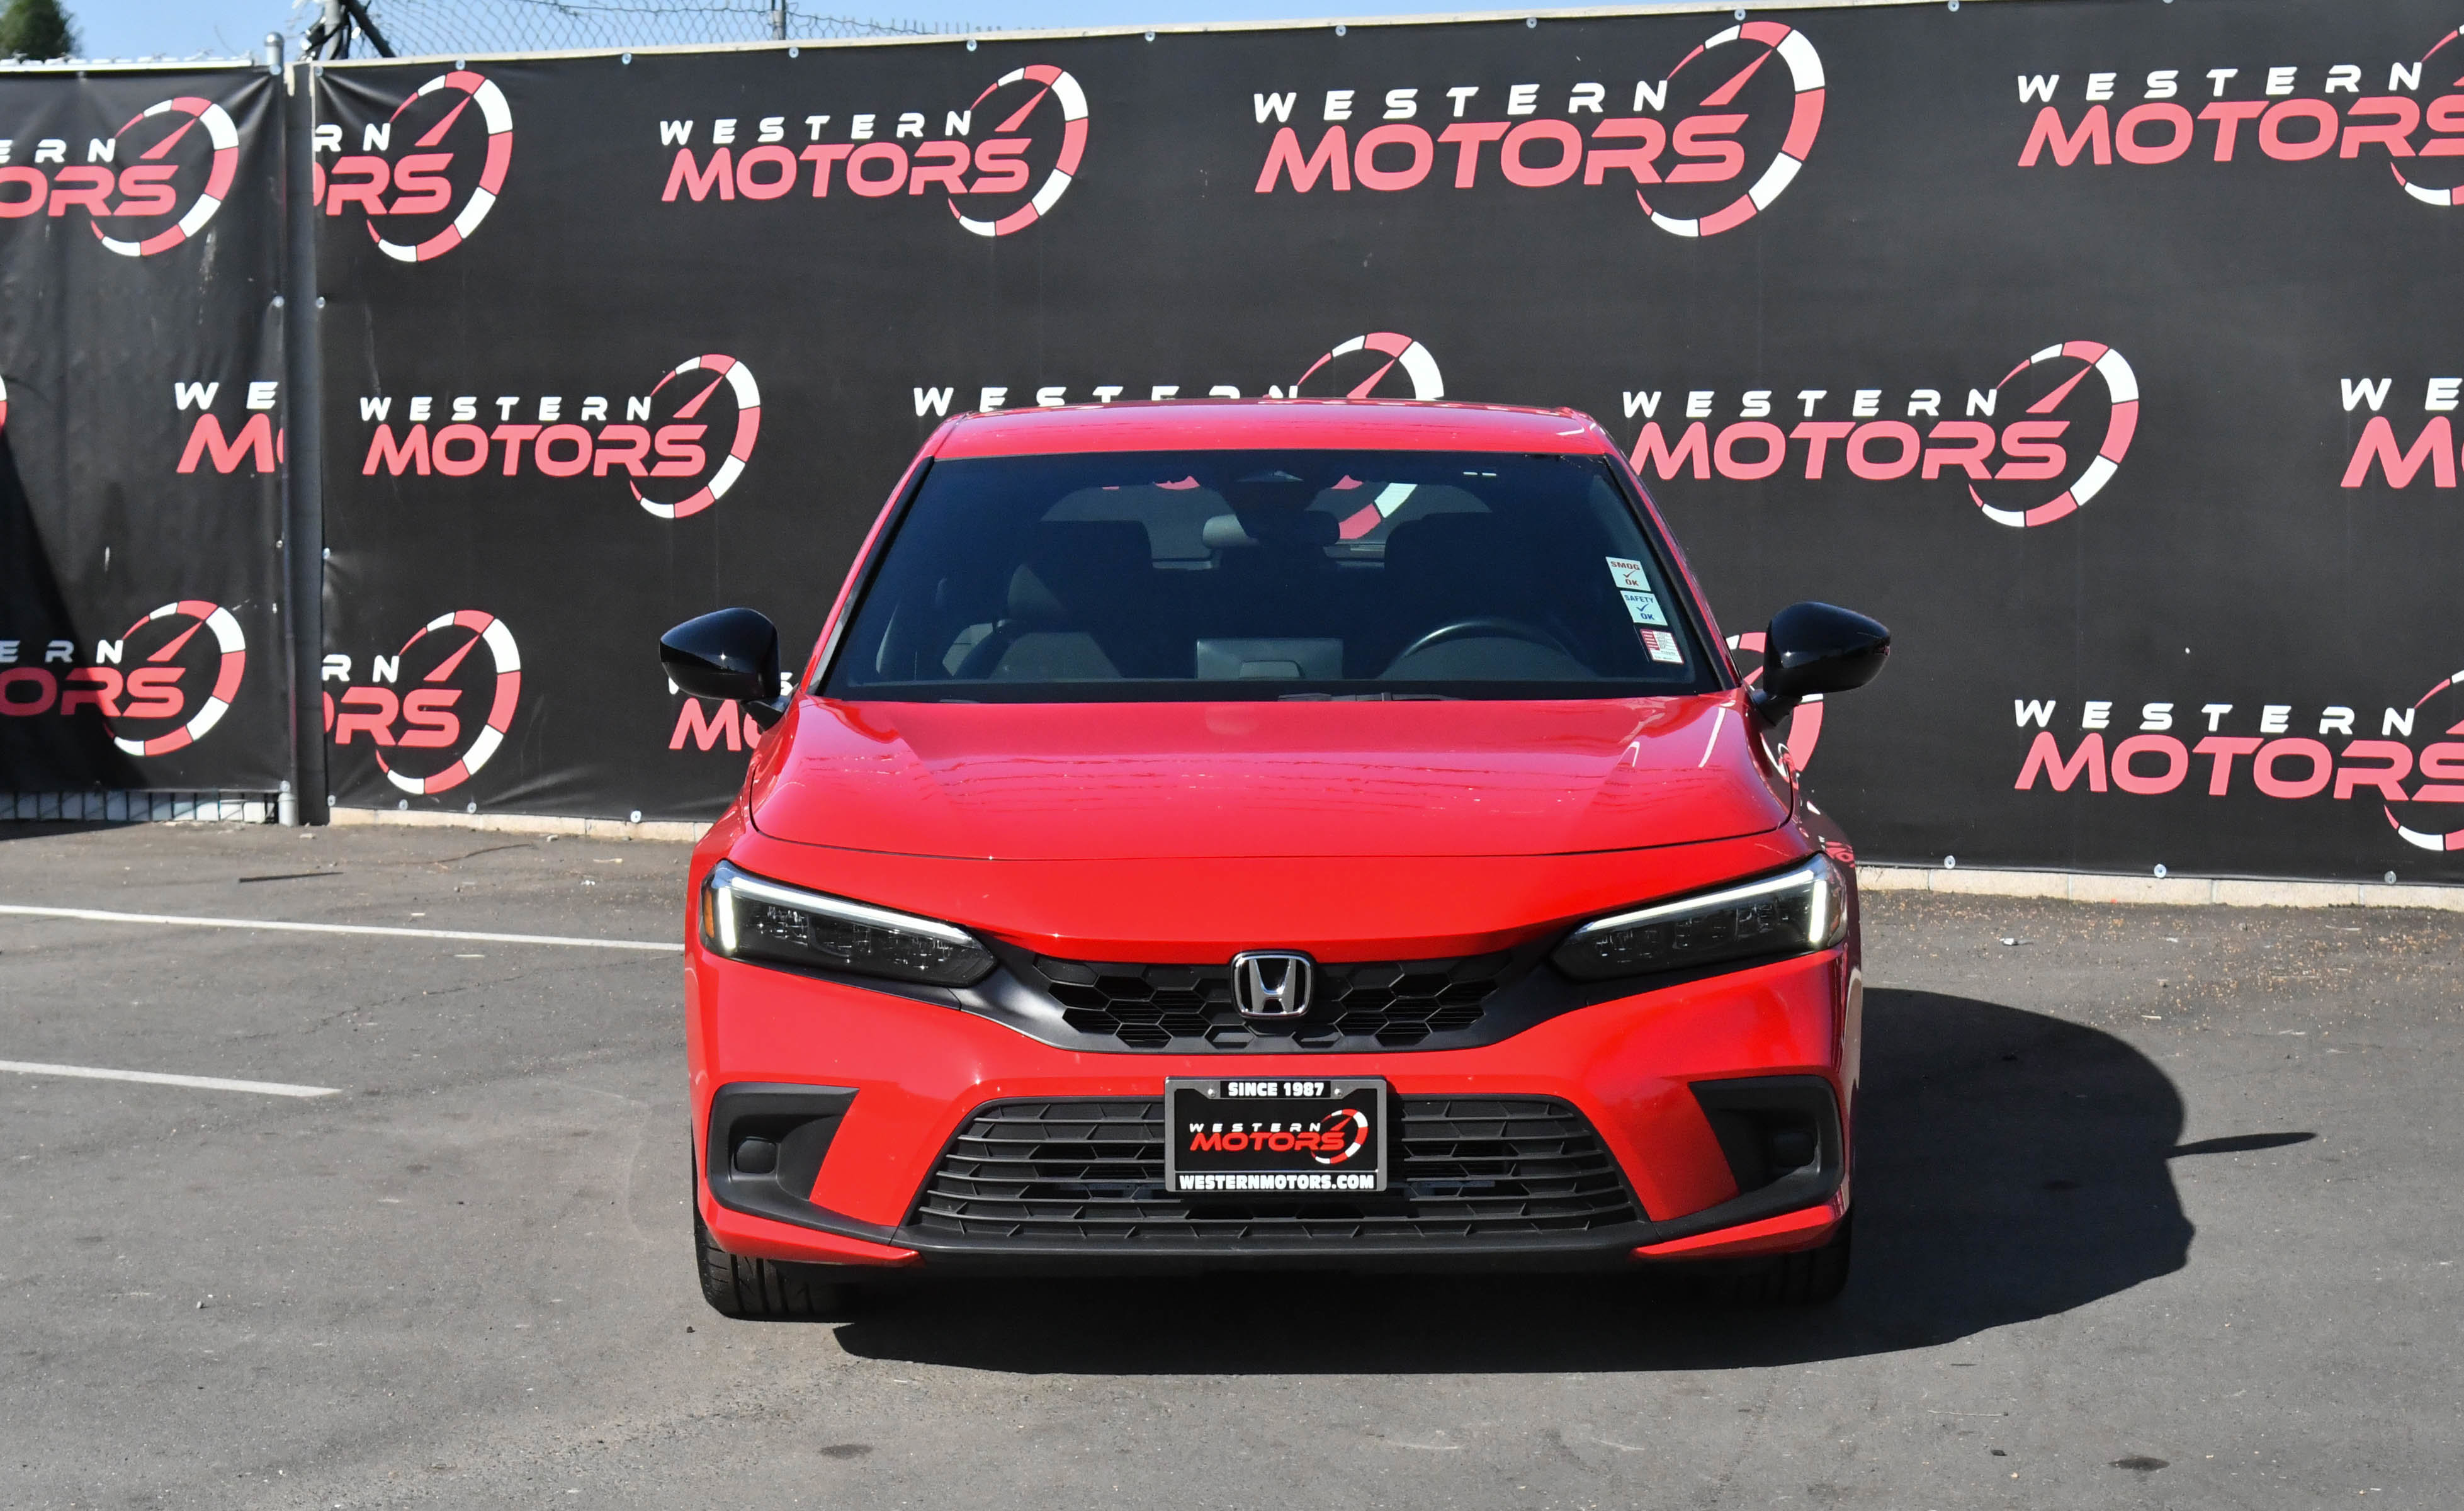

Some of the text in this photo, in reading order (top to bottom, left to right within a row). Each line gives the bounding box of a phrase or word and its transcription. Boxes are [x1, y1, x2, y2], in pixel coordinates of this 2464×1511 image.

[1254, 80, 1668, 123] WESTERN
[2017, 62, 2422, 103] WESTERN
[660, 110, 971, 145] WESTERN
[662, 139, 1032, 201] MOTORS
[1255, 114, 1749, 193] MOTORS
[0, 165, 179, 218] ORS
[314, 153, 454, 215] RS
[360, 396, 651, 421] WESTERN
[1622, 389, 1997, 418] WESTERN
[362, 424, 708, 477] MOTORS
[1629, 421, 2071, 480] MOTORS
[1610, 561, 1641, 570] SMOG
[1624, 594, 1654, 603] SAFETY
[0, 667, 186, 719] ORS
[322, 686, 463, 748] RS
[2015, 699, 2415, 736] WESTERN
[2015, 730, 2464, 803] MOTORS
[1228, 1082, 1325, 1097] SINCE 1987
[1189, 1123, 1321, 1133] WESTERN
[1190, 1132, 1345, 1152] MOTORS
[1179, 1174, 1374, 1190] WESTERNMOTORS.COM
